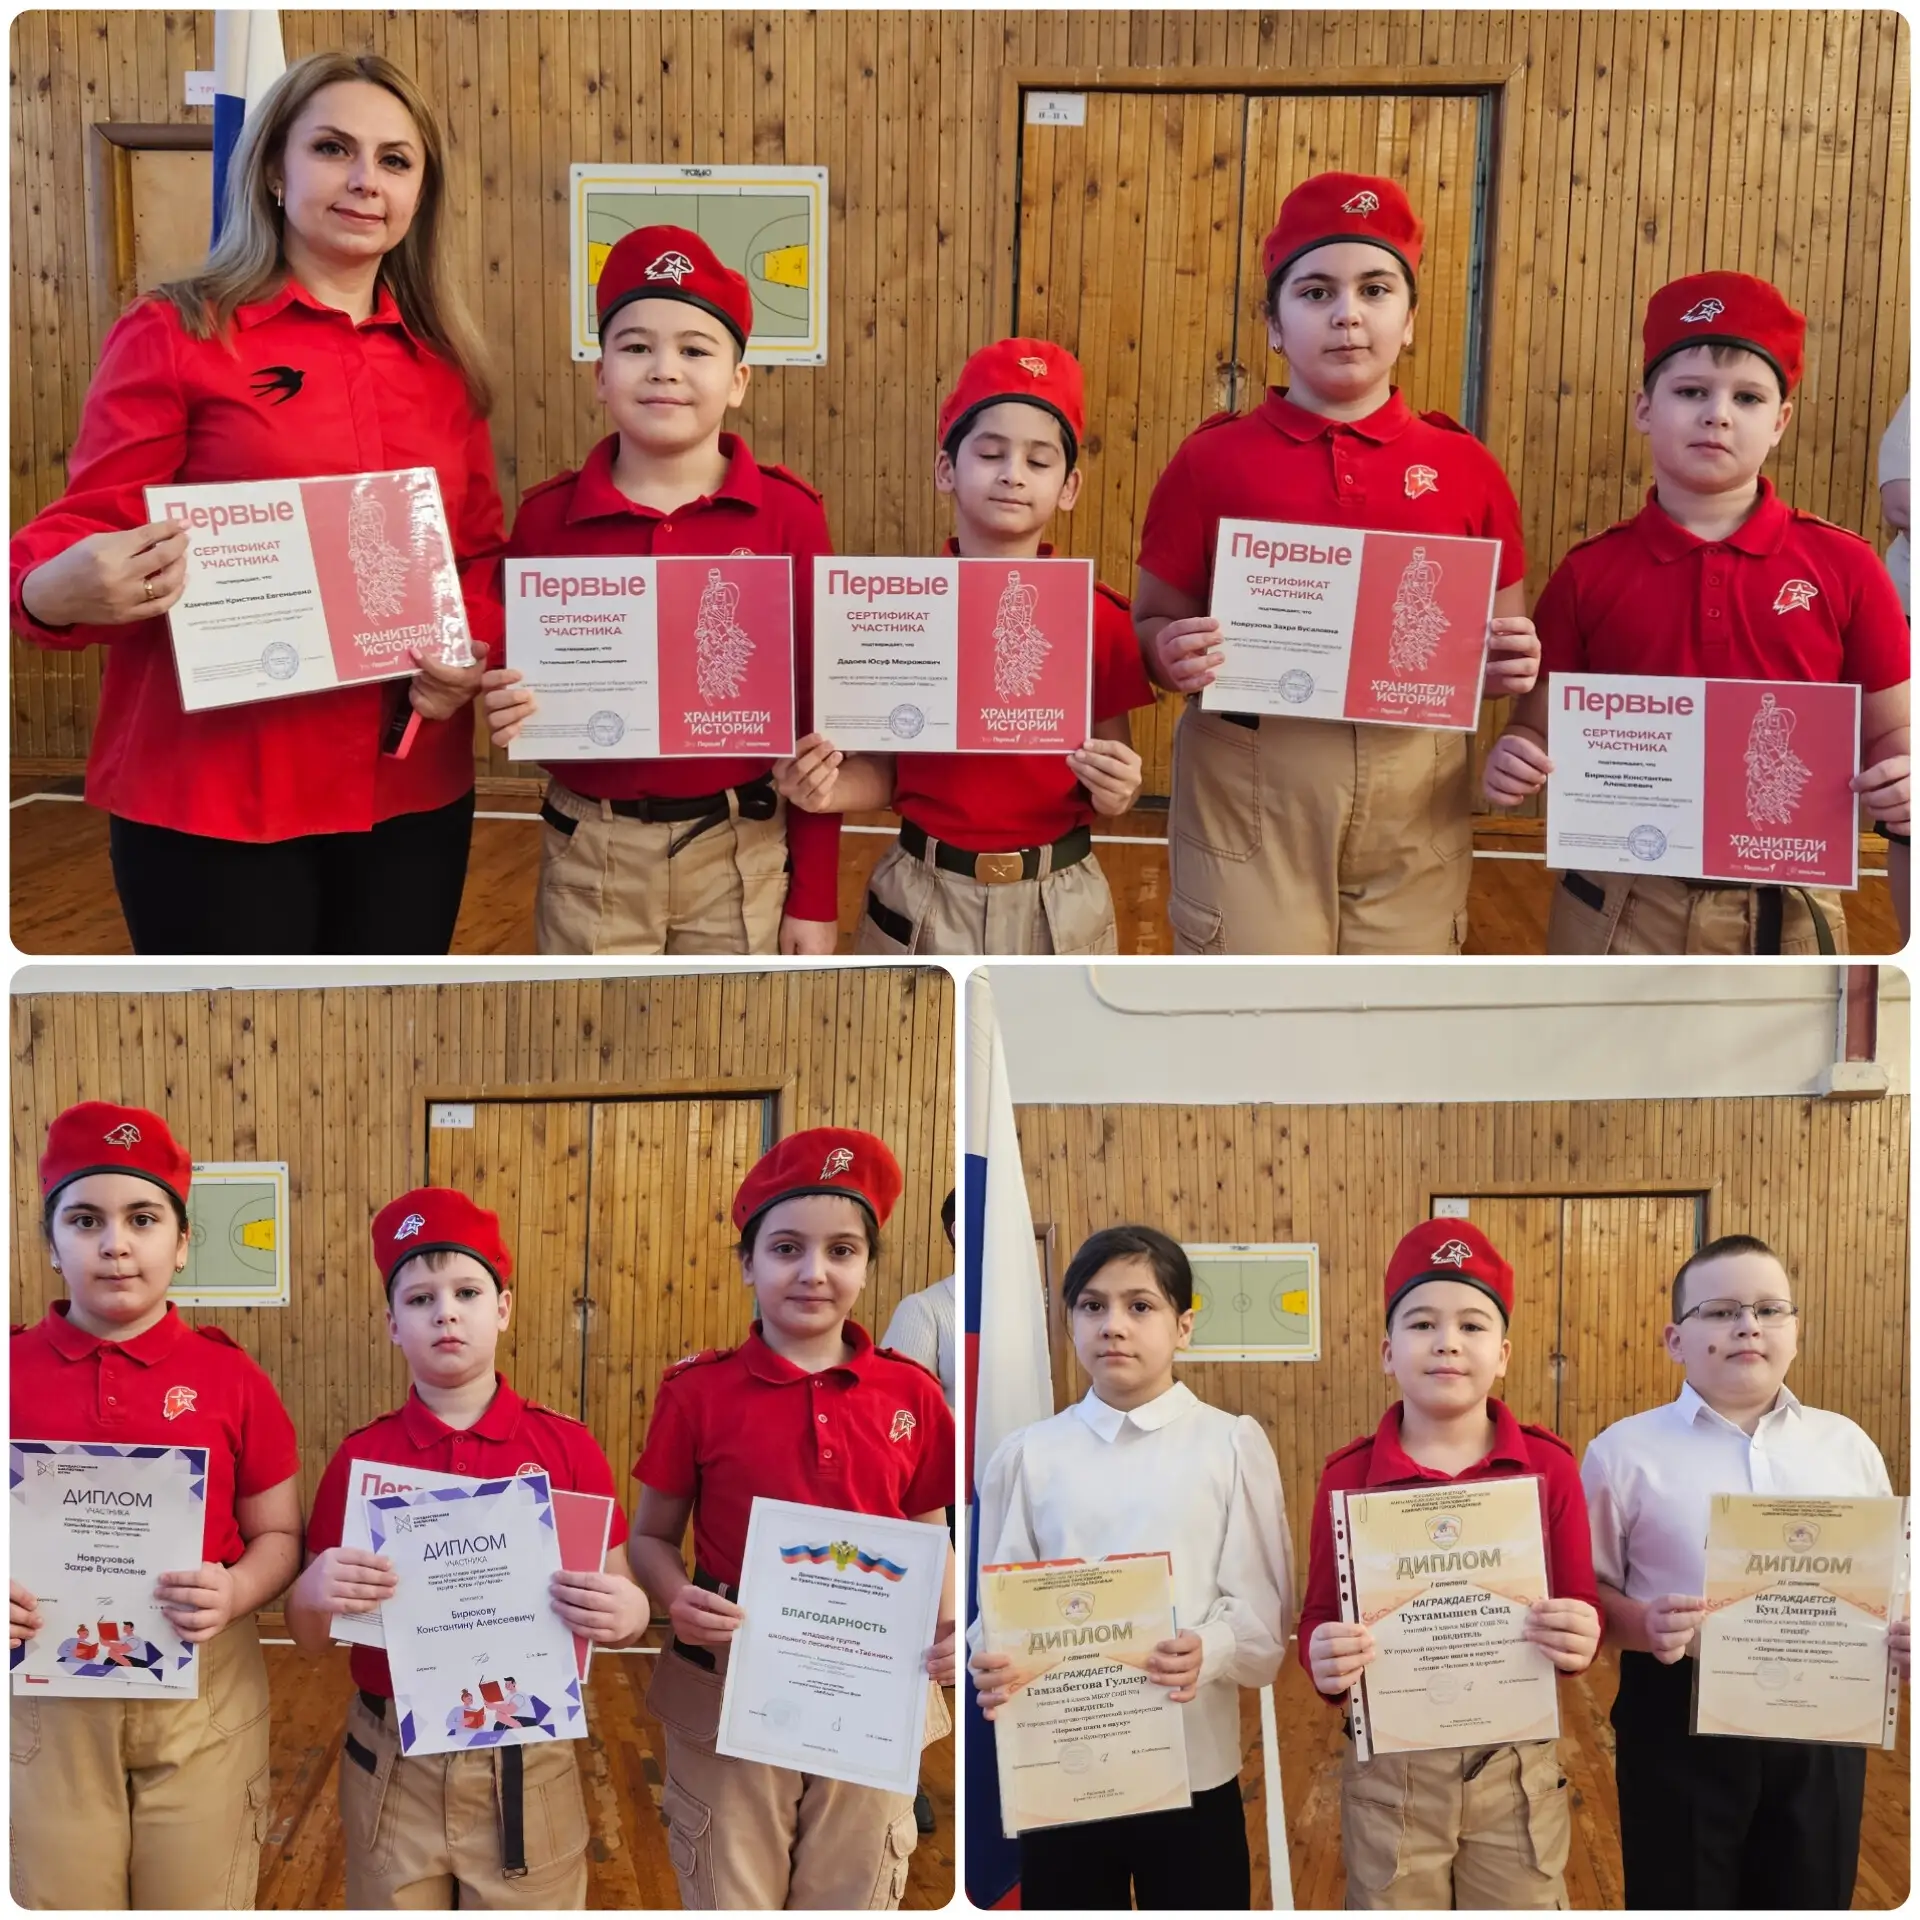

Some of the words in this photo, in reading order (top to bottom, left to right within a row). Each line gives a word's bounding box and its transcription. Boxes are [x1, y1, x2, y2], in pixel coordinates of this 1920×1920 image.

[165, 501, 294, 536] Первые
[194, 540, 281, 557] СЕРТИФИКАТ
[1231, 532, 1352, 568] Первые
[201, 555, 279, 569] УЧАСТНИКА
[520, 572, 646, 605] Первые
[829, 570, 948, 602] Первые
[1246, 575, 1330, 590] СЕРТИФИКАТ
[226, 595, 265, 604] Кристина
[266, 589, 312, 599] Евгеньевна
[1250, 587, 1324, 601] УЧАСТНИКА
[539, 613, 627, 624] СЕРТИФИКАТ
[846, 611, 930, 621] СЕРТИФИКАТ
[353, 622, 439, 646] ХРАНИТЕЛИ
[544, 626, 622, 636] УЧАСТНИКА
[851, 623, 925, 633] УЧАСТНИКА
[1298, 626, 1338, 634] Вусаловна
[363, 635, 434, 656] ИСТОРИИ
[1370, 680, 1455, 696] ХРАНИТЕЛИ
[1376, 692, 1447, 707] ИСТОРИИ
[1563, 686, 1694, 720] Первые
[684, 711, 771, 723] ХРАНИТЕЛИ
[981, 708, 1064, 720] ХРАНИТЕЛИ
[691, 723, 763, 735] ИСТОРИИ
[987, 720, 1057, 731] ИСТОРИИ
[1582, 728, 1673, 741] СЕРТИФИКАТ
[1587, 740, 1668, 753] УЧАСТНИКА
[1585, 772, 1622, 780] Бирюков
[1623, 774, 1672, 782] Константин
[1603, 781, 1653, 789] Алексеевич
[1729, 834, 1826, 852] ХРАНИТЕЛИ
[1737, 847, 1818, 863] ИСТОРИИ
[361, 1474, 413, 1496] Пер
[63, 1489, 152, 1508] ДИПЛОМ
[86, 1508, 130, 1516] УЧАСТНИКА
[423, 1533, 507, 1561] ДИПЛОМ
[77, 1553, 135, 1565] Новрузовой
[445, 1556, 488, 1567] УЧАСТНИКА
[1396, 1549, 1501, 1580] ДИПЛОМ
[1745, 1554, 1853, 1575] ДИПЛОМ
[64, 1563, 93, 1573] Захре
[96, 1565, 147, 1576] Вусаловне
[1413, 1593, 1491, 1608] НАГРАЖДАЕТСЯ
[1755, 1594, 1836, 1603] НАГРАЖДАЕТСЯ
[452, 1607, 496, 1619] Бирюкову
[1399, 1608, 1478, 1623] Тухтамышев
[1480, 1605, 1511, 1616] Саид
[1756, 1605, 1780, 1617] Куц
[1781, 1607, 1837, 1616] Дмитрий
[416, 1621, 474, 1635] Константину
[476, 1613, 535, 1628] Алексеевичу
[781, 1607, 887, 1634] БЛАГОДАРНОСТЬ
[768, 1632, 807, 1645] школьного
[836, 1637, 861, 1646] группе
[1028, 1621, 1133, 1655] ДИПЛОМ
[1432, 1632, 1482, 1641] ПОБЕДИТЕЛЬ
[1068, 1652, 1100, 1661] степени
[1044, 1665, 1123, 1681] НАГРАЖДАЕТСЯ
[1027, 1681, 1102, 1697] Гамзабегова
[1105, 1676, 1147, 1688] Гуллер
[1064, 1702, 1114, 1713] ПОБЕДИТЕЛЬ
